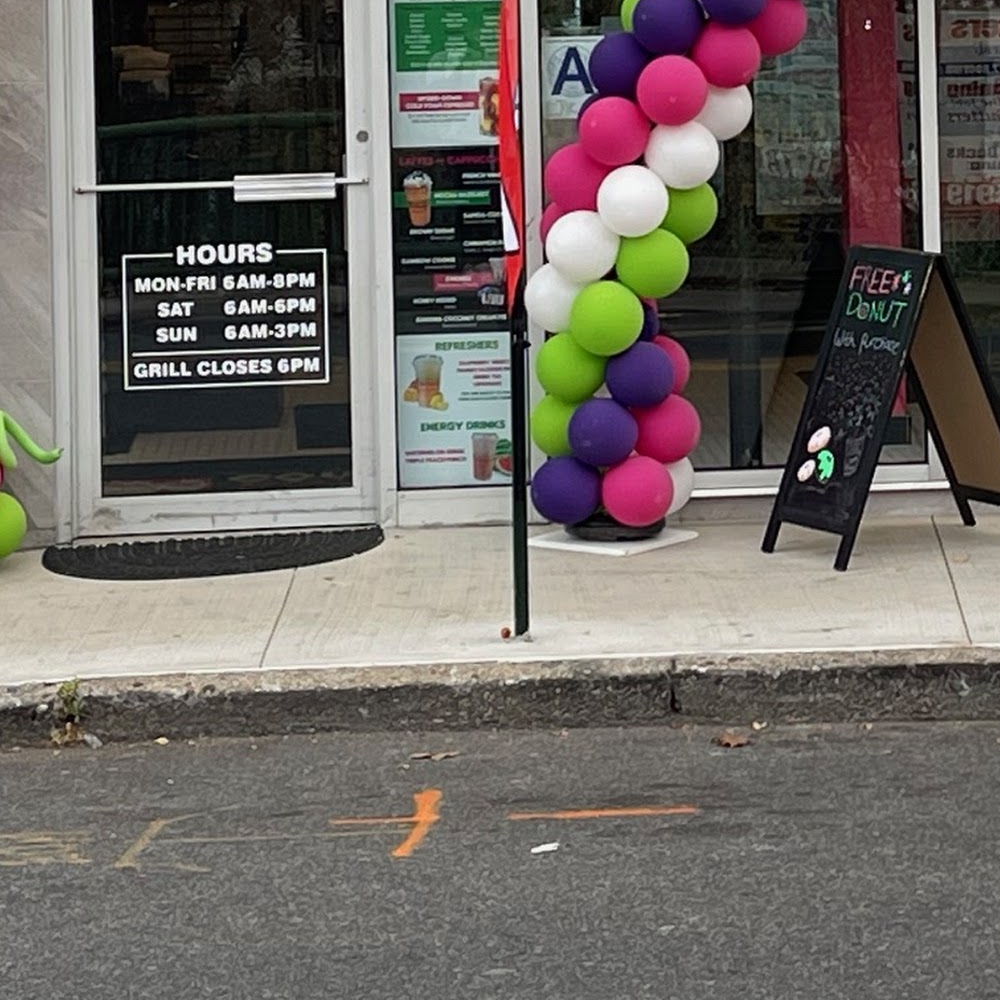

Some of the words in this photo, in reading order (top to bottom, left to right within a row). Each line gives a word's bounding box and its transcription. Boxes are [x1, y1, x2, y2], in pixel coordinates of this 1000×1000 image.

[551, 46, 595, 96] A
[176, 241, 274, 266] HOURS
[134, 275, 217, 294] MON-FRI
[222, 272, 316, 291] 6AM-8PM
[157, 301, 195, 319] SAT
[223, 297, 316, 316] 6AM-6PM
[156, 326, 198, 344] SUN
[224, 322, 317, 341] 6AM-3PM
[435, 340, 499, 351] REFRESHERS
[133, 362, 192, 379] GRILL
[196, 359, 273, 377] CLOSES
[277, 357, 321, 374] 6PM
[420, 420, 463, 432] ENERGY
[466, 419, 506, 430] DRINKS
